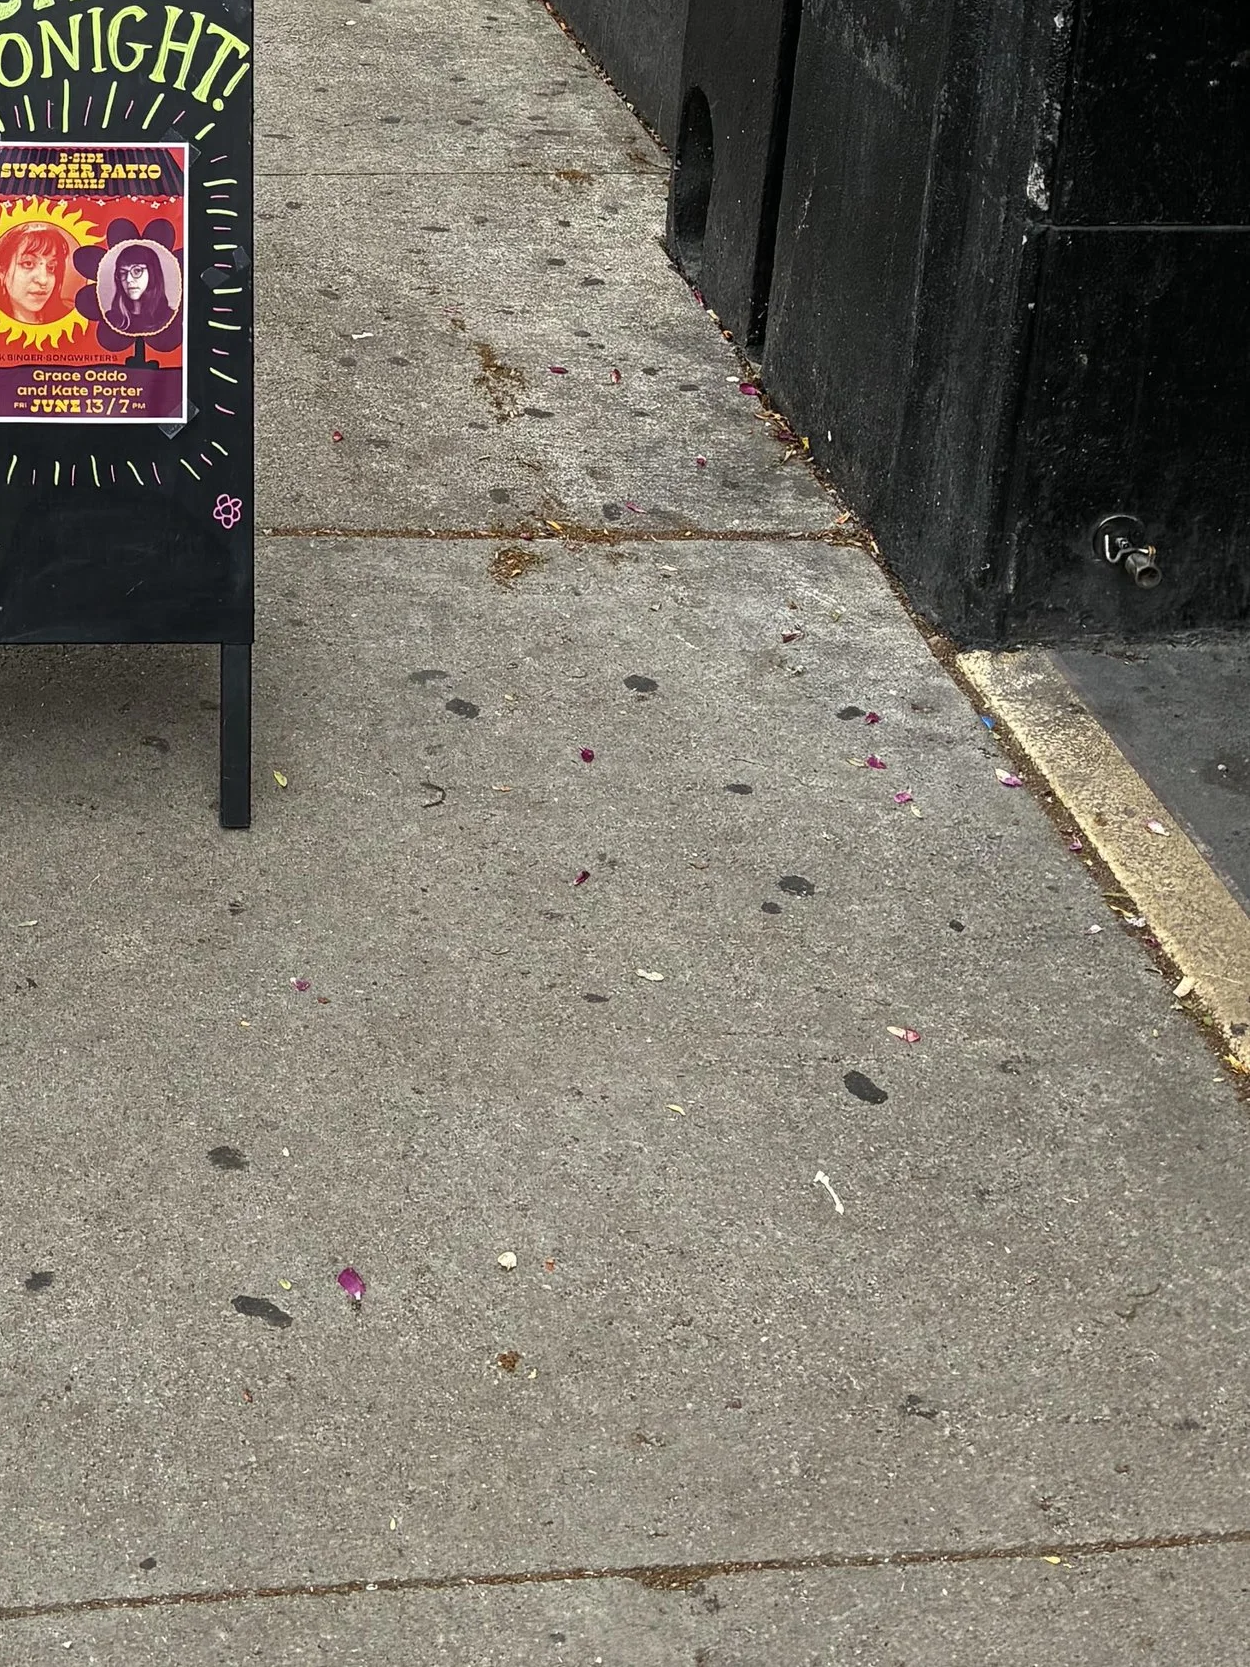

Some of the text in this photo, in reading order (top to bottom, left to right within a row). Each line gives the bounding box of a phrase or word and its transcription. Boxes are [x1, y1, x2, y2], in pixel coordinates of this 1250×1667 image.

[59, 152, 104, 164] B-SIDE
[0, 163, 161, 180] SUMMER PATIO
[57, 178, 106, 190] SERIES
[33, 370, 128, 382] Grace Oddo
[16, 385, 143, 397] and Kate Porter
[13, 401, 28, 410] FRI
[30, 399, 82, 414] JUNE
[85, 399, 104, 414] 13
